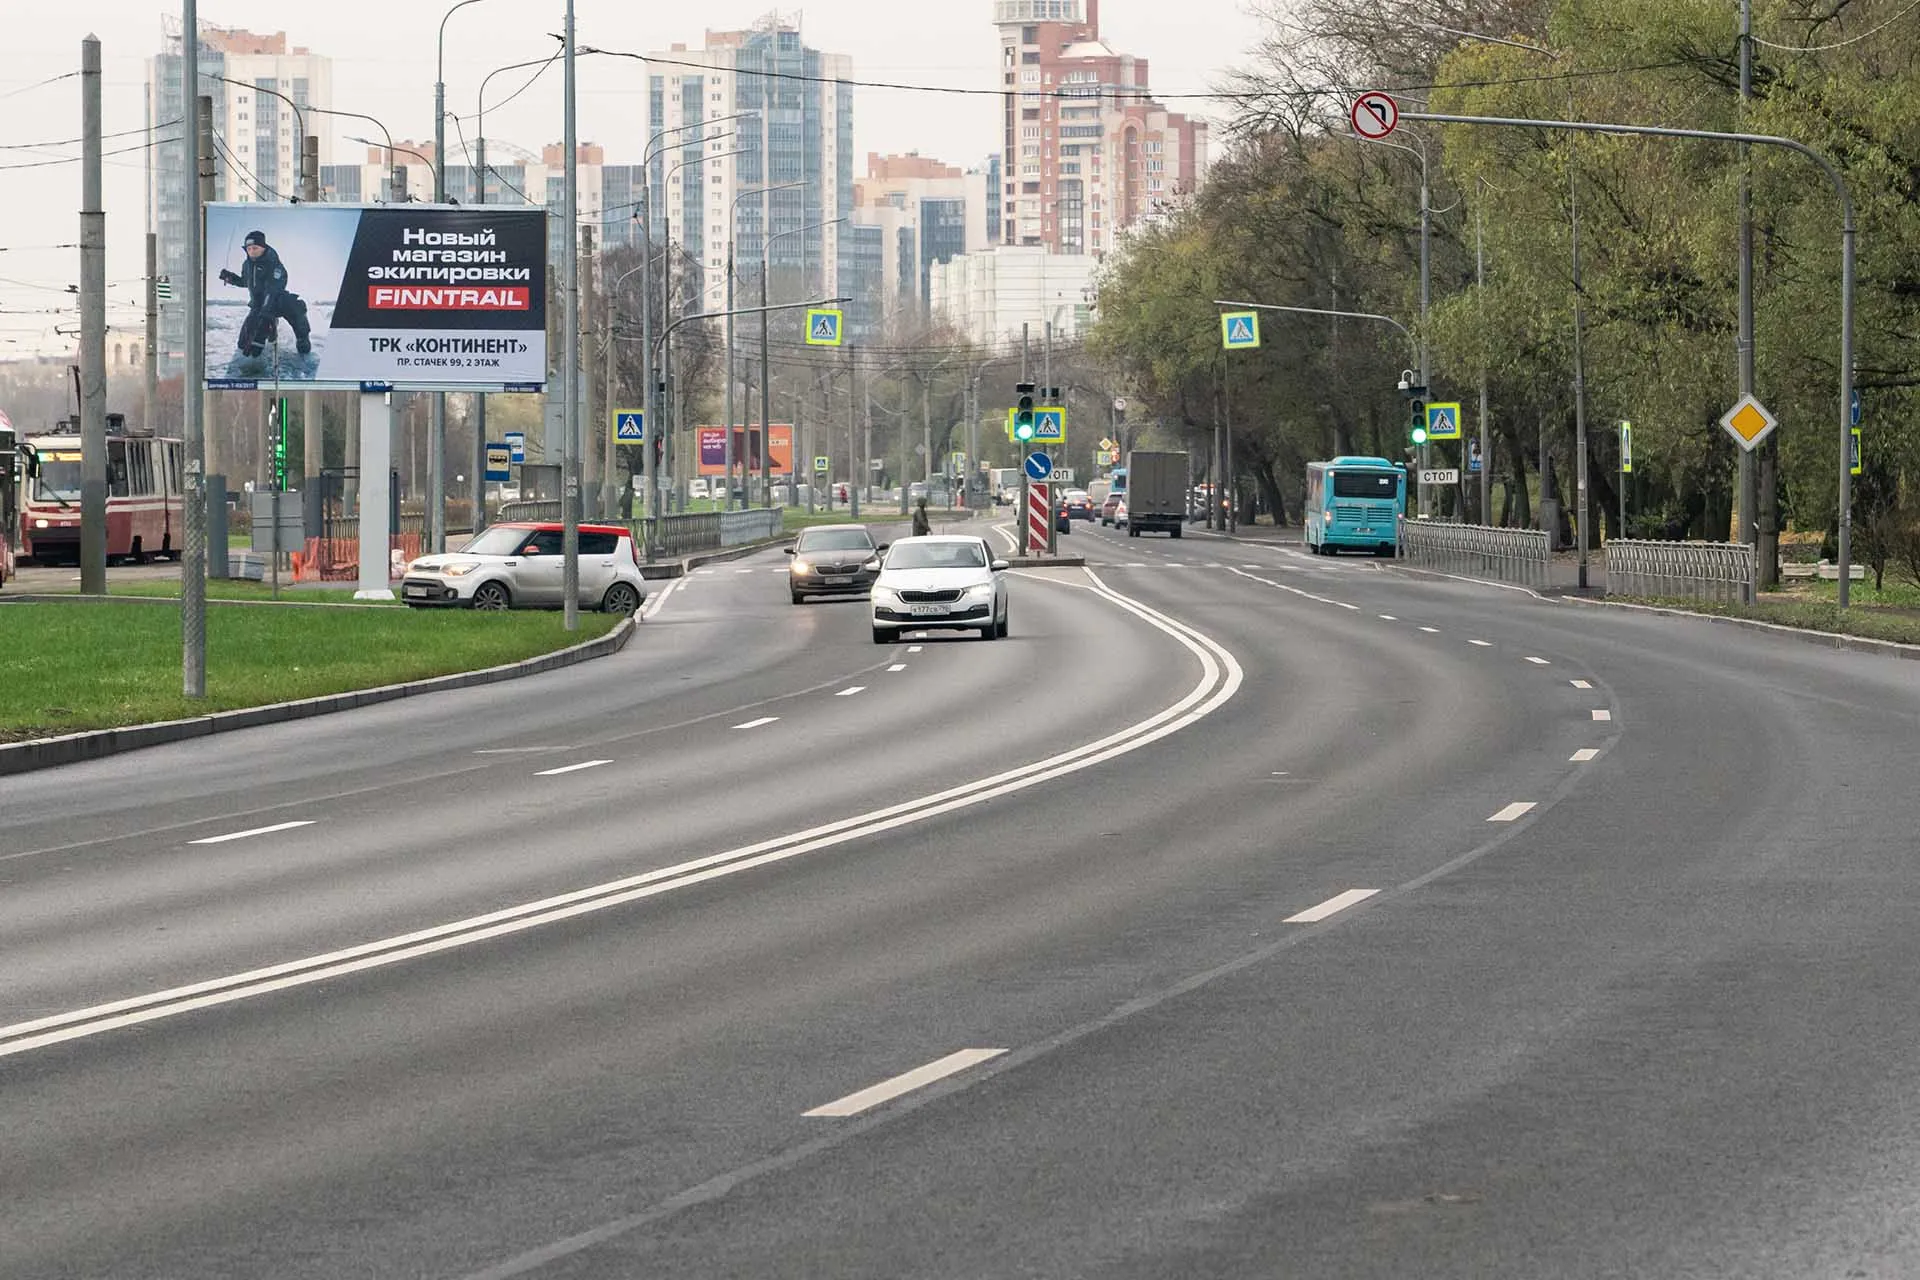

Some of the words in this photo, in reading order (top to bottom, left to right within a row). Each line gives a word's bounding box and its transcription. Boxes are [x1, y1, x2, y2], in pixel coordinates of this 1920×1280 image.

[403, 228, 496, 246] Новый
[392, 249, 506, 263] магазин
[367, 266, 530, 284] экипировки
[375, 288, 522, 306] FINNTRAIL
[369, 337, 402, 353] ТРК
[405, 338, 528, 354] «КОНТИНЕНТ»
[397, 357, 412, 367] ПР.
[413, 358, 448, 367] СТАЧЕК
[449, 358, 465, 368] 99,
[466, 358, 473, 367] 2
[474, 358, 500, 367] ЭТАЖ
[1423, 471, 1453, 482] СТОП
